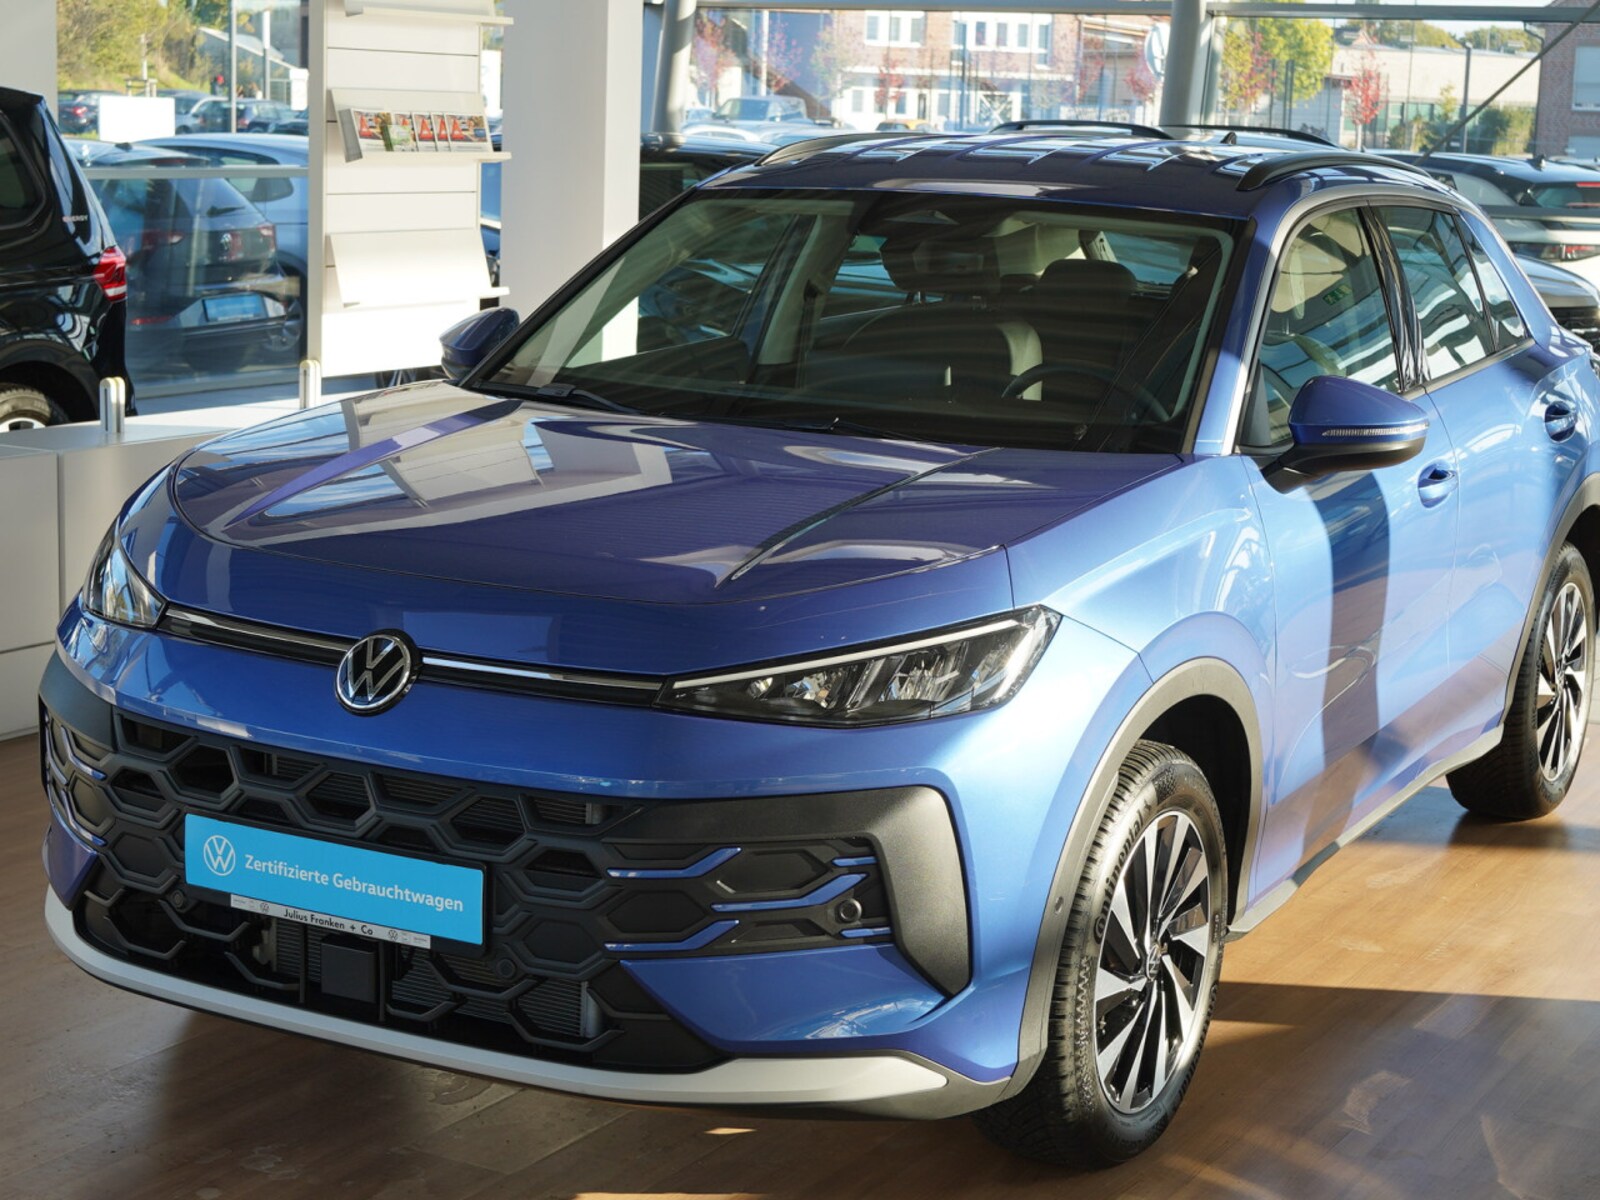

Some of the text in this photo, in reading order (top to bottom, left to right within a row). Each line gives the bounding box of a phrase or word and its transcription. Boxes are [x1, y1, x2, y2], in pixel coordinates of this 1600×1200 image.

[336, 634, 411, 709] VW
[203, 834, 236, 876] VW
[244, 854, 464, 912] Zertifizierte Gebrauchtwagen
[283, 908, 308, 922] Julius
[310, 914, 345, 930] Franken
[360, 924, 374, 936] Co
